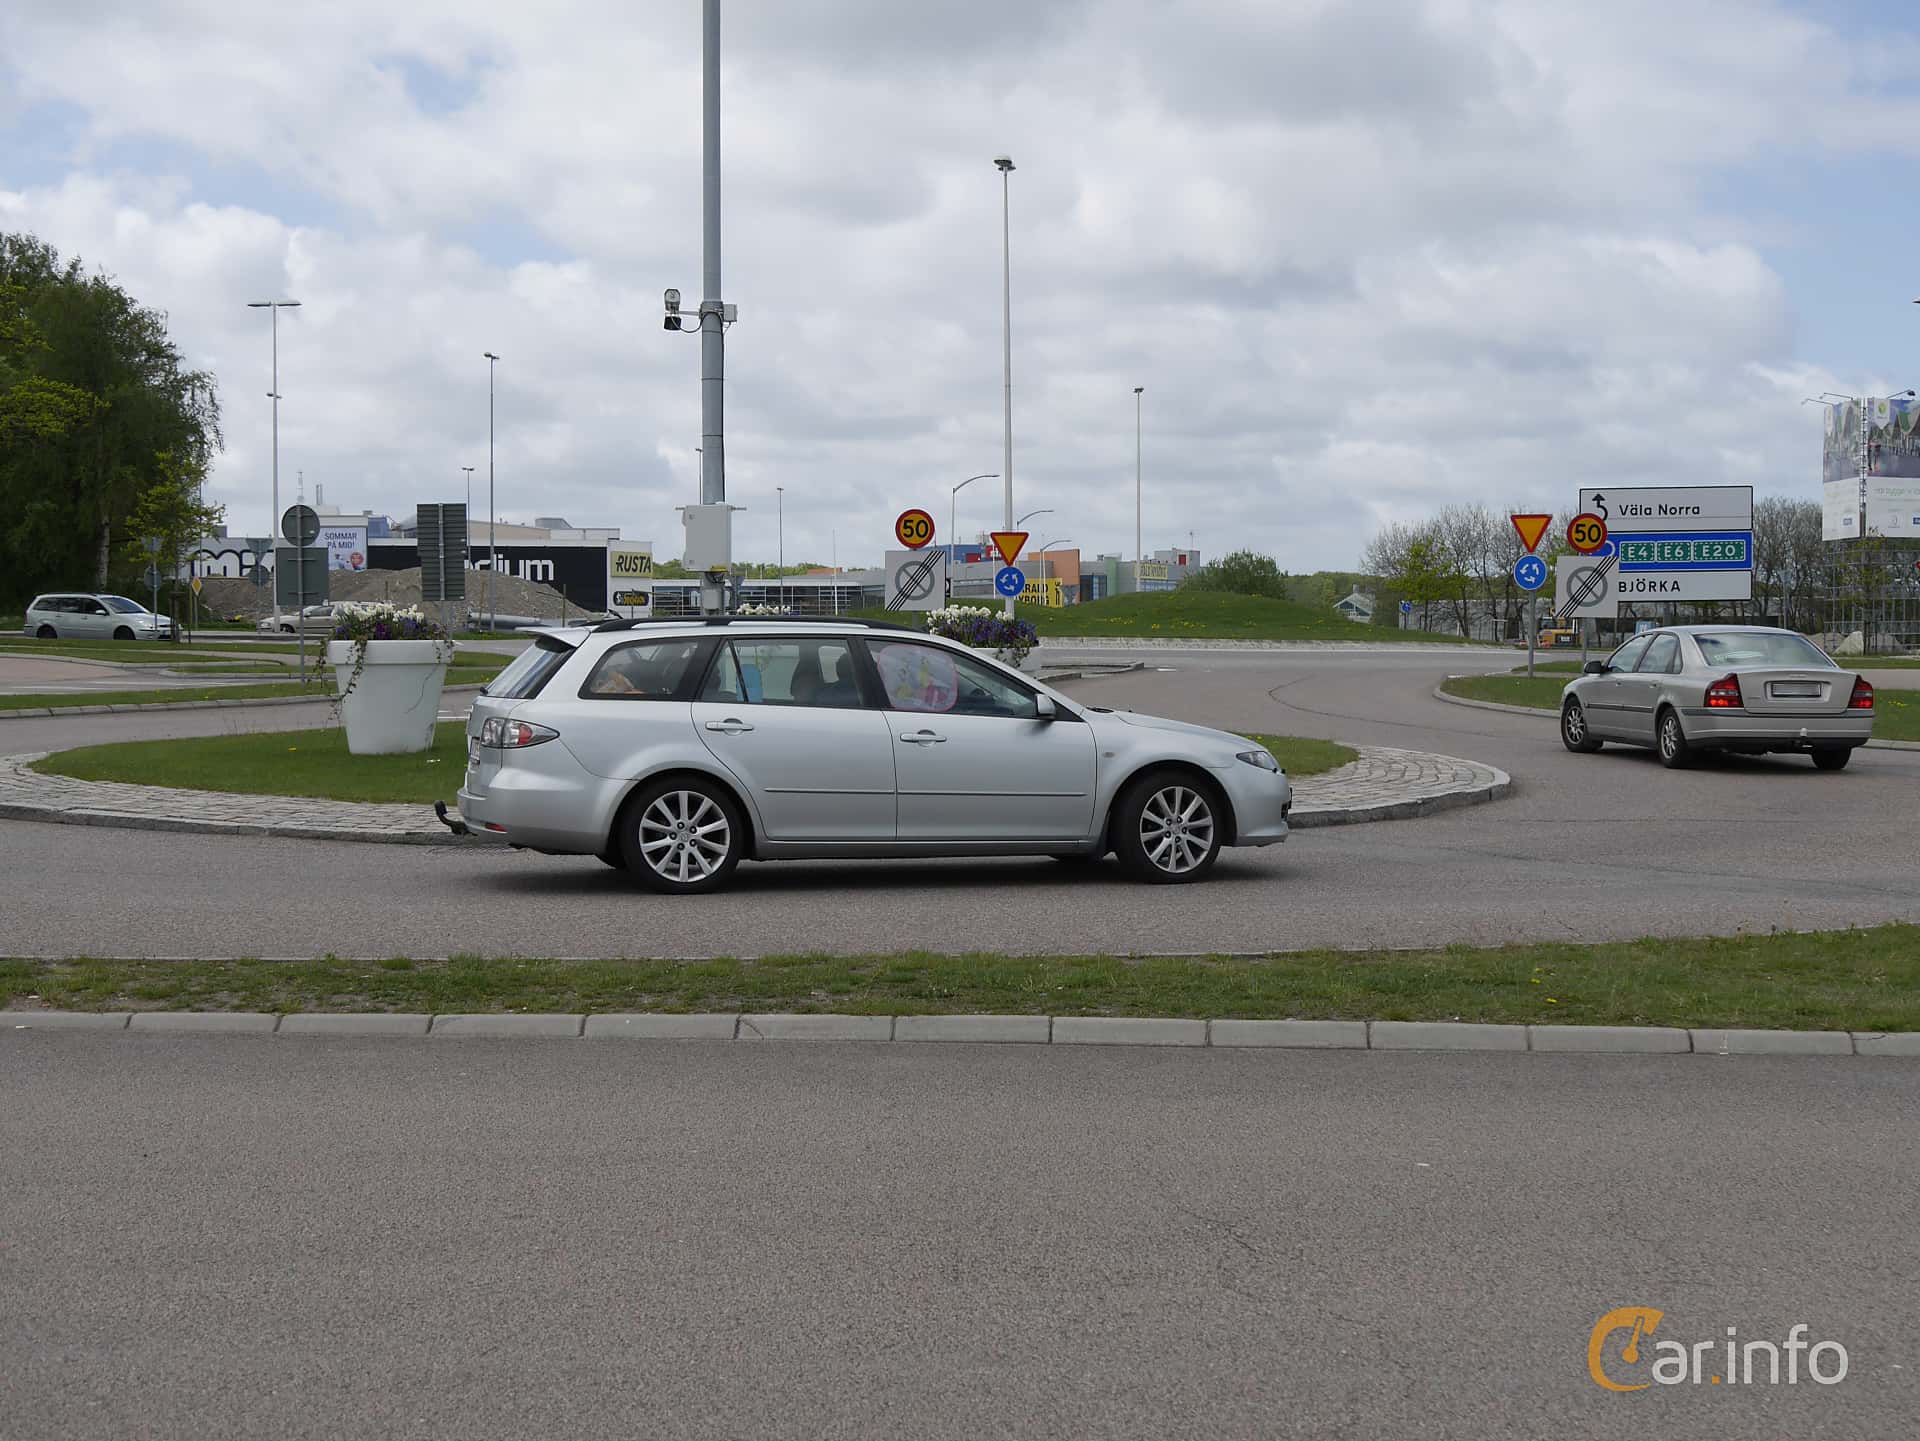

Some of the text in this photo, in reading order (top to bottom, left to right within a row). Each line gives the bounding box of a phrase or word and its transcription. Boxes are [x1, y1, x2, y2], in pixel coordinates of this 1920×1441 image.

[1619, 504, 1700, 516] Väla Norra
[903, 519, 929, 538] 50
[1574, 524, 1602, 543] 50
[324, 532, 357, 540] SOMMAR
[1628, 547, 1648, 558] E4
[1664, 546, 1684, 557] E6
[1702, 545, 1736, 556] E20
[615, 554, 652, 573] RUSTA
[1618, 578, 1680, 593] BJÖRKA
